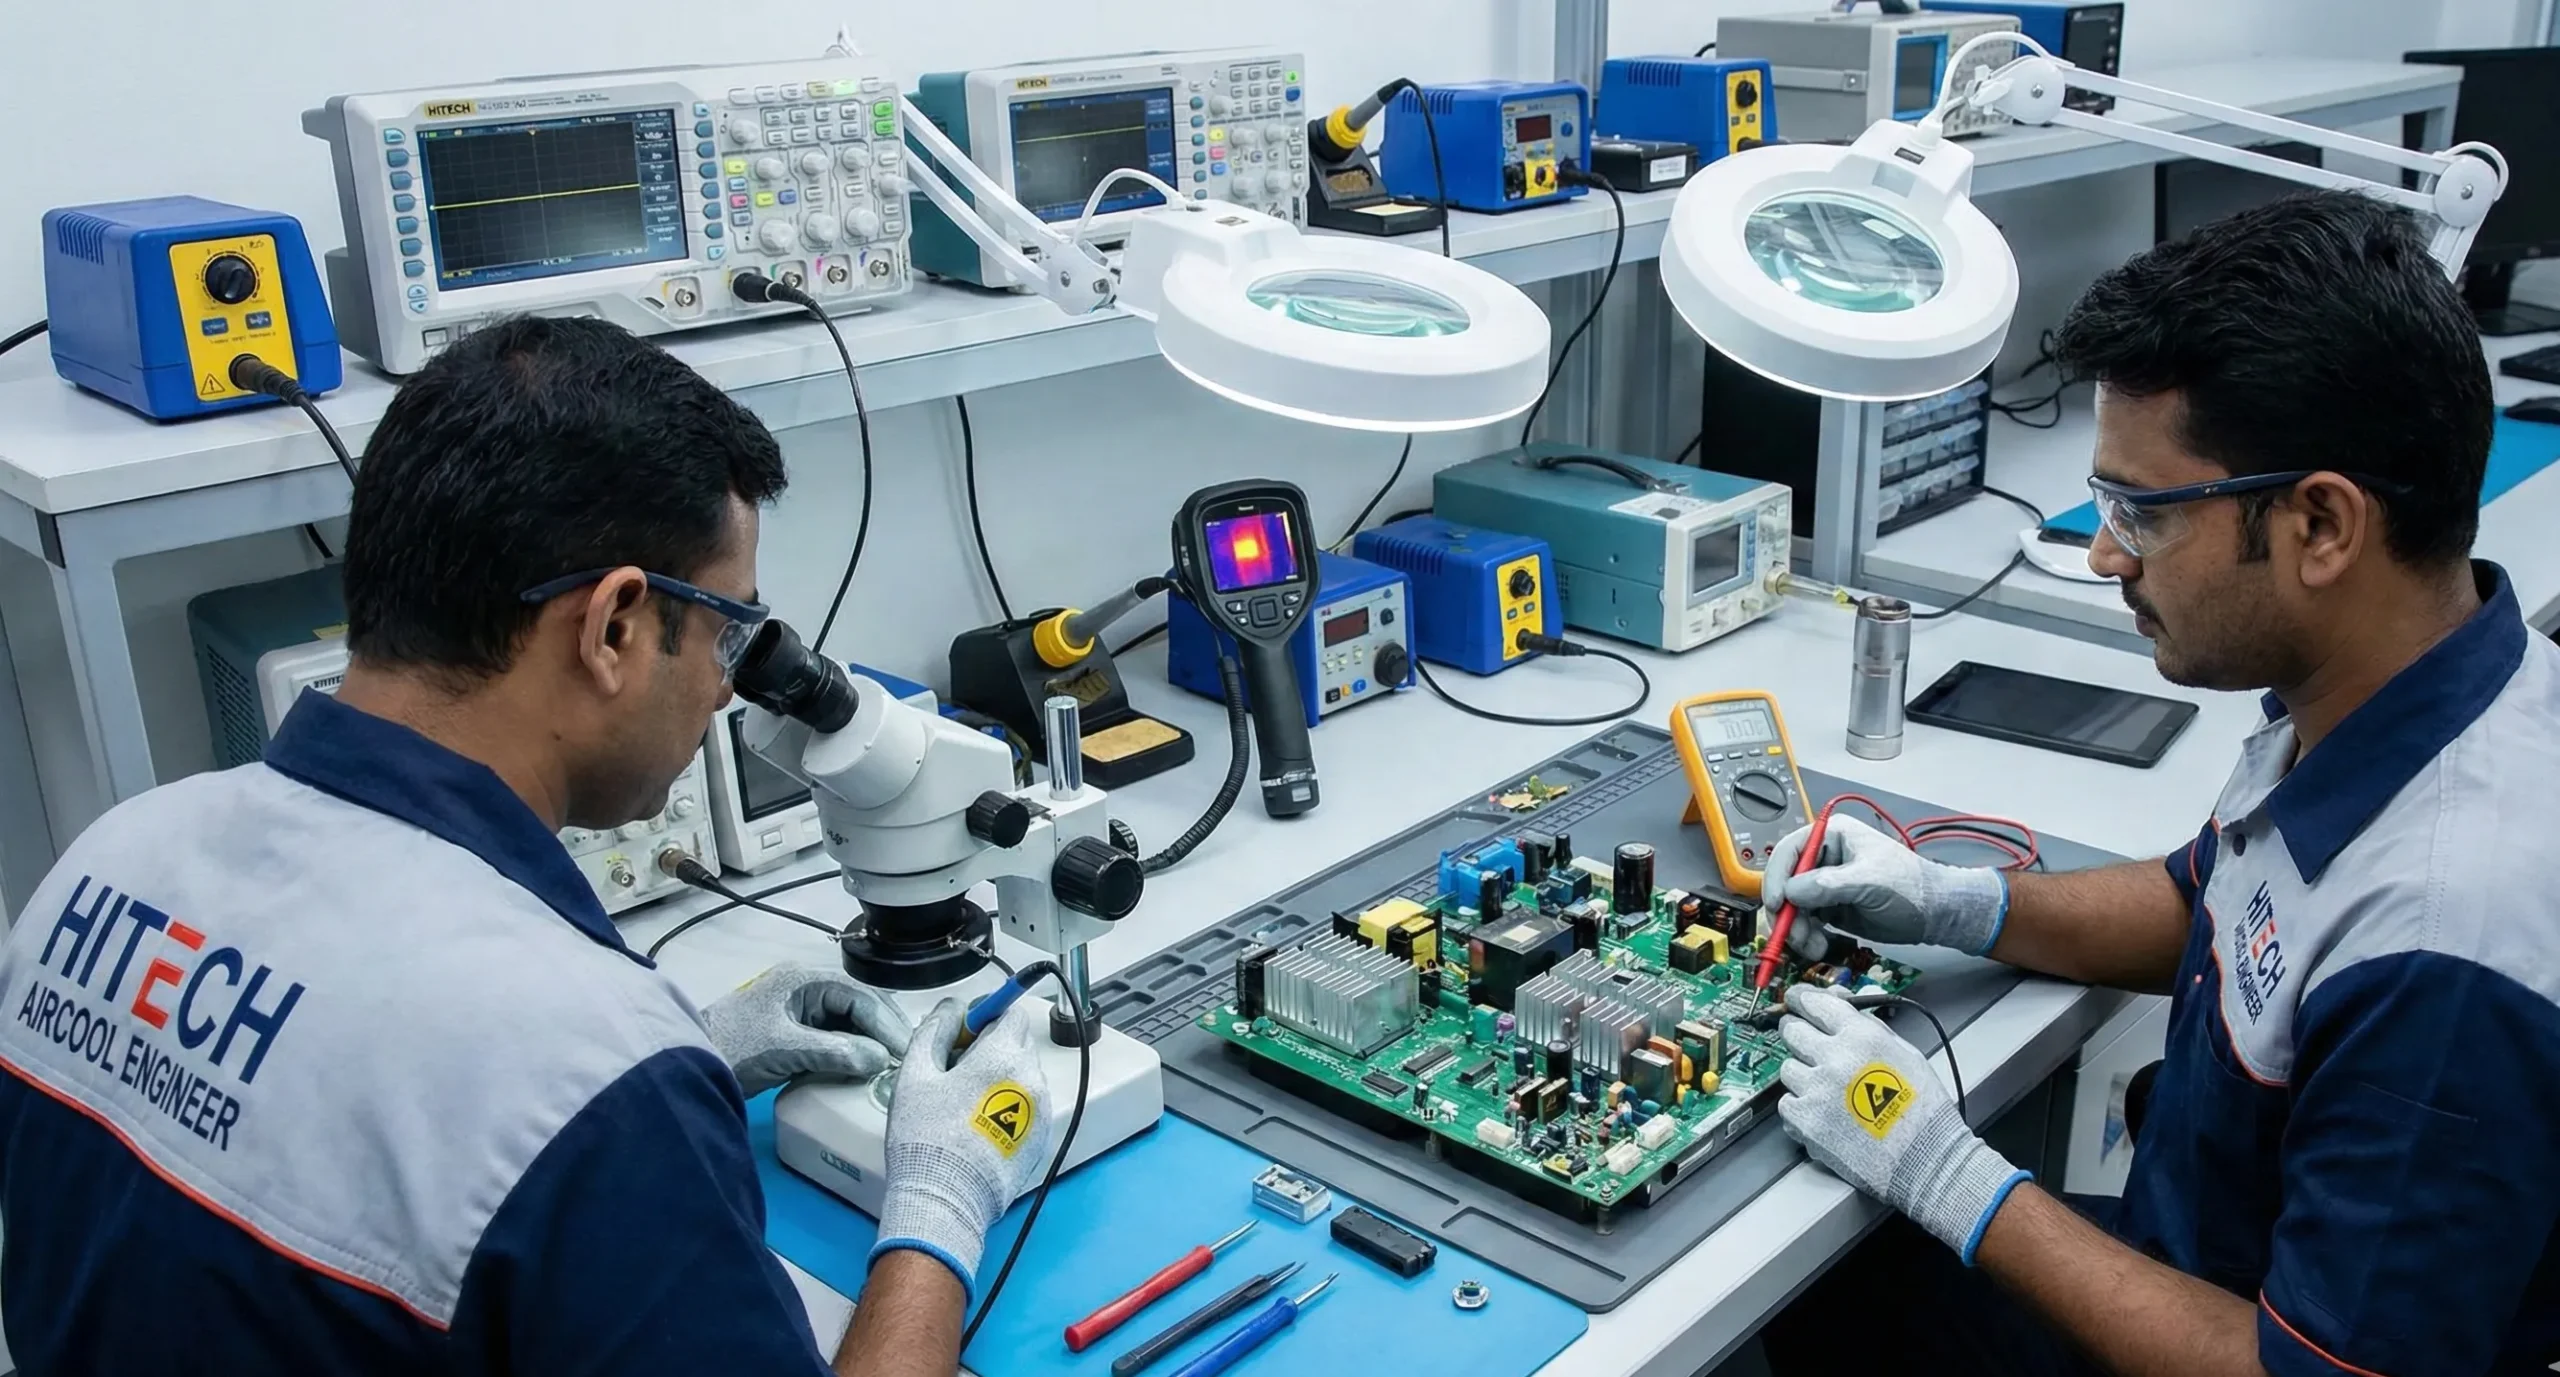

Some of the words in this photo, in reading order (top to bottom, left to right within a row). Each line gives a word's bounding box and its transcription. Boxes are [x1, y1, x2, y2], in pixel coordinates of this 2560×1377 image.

[428, 102, 471, 116] HITECH
[39, 875, 306, 1085] HITECH
[2247, 880, 2286, 999] HITECH
[17, 981, 118, 1073] AIRCOOL
[120, 1035, 240, 1151] ENGINEER
